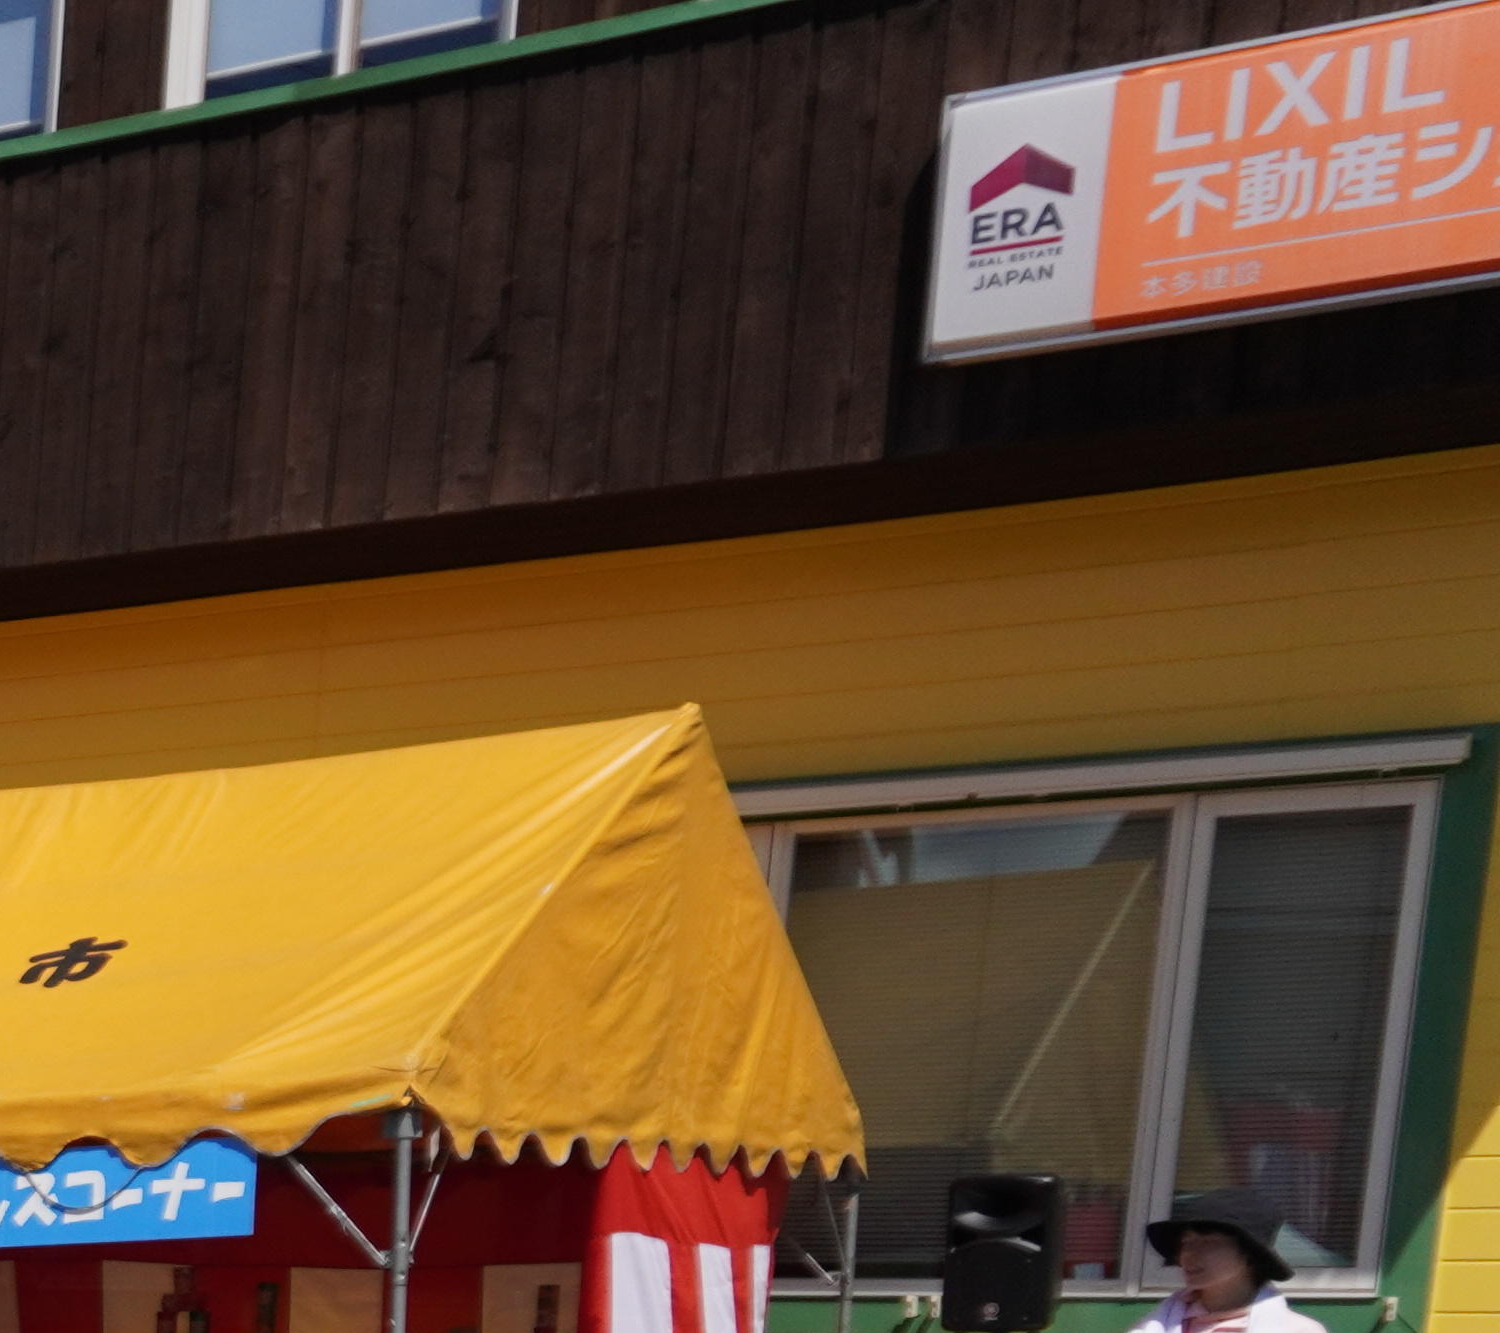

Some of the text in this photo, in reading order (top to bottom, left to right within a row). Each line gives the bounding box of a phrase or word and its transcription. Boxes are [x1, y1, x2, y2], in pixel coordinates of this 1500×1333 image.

[1155, 38, 1446, 154] LIXIL
[1145, 119, 1500, 239] 不動産シ
[971, 202, 1064, 245] ERA
[967, 246, 1064, 270] REAL ESTATE
[972, 263, 1054, 292] JAPAN
[1139, 260, 1264, 300] 本多建設
